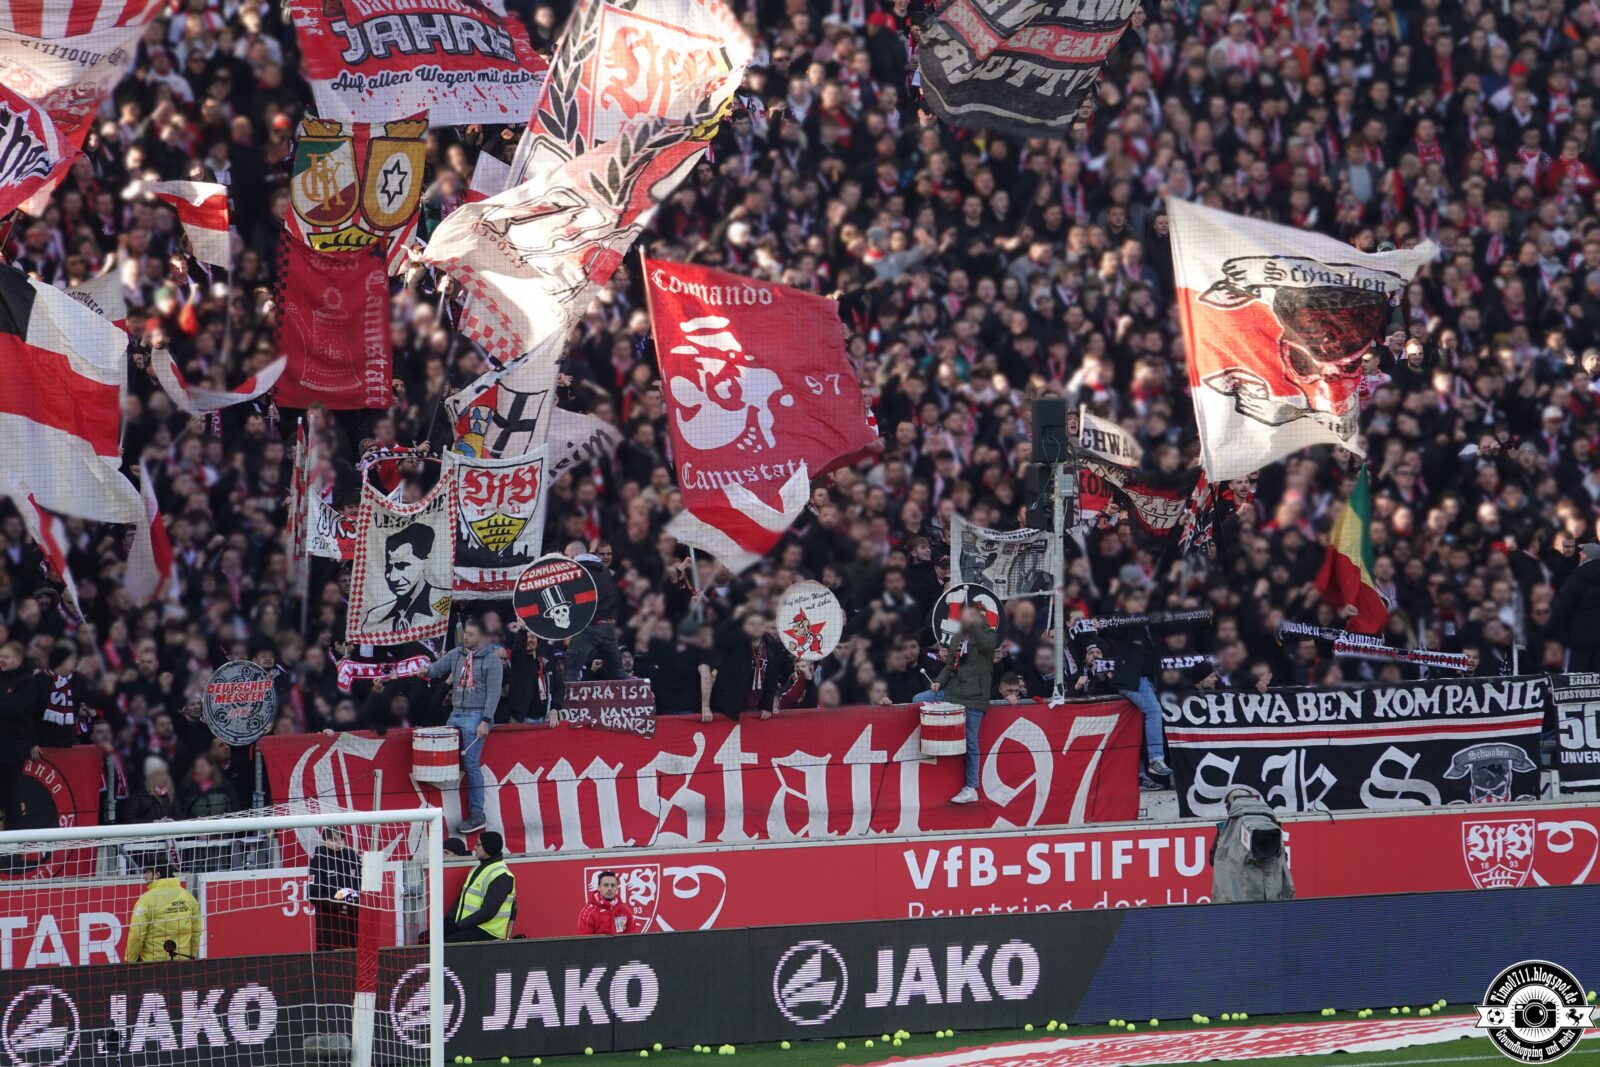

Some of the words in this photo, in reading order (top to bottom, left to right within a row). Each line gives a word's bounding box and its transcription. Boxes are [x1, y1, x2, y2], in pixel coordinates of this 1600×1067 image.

[331, 14, 518, 65] JAHRE
[331, 72, 366, 92] Auf
[367, 71, 412, 90] allen
[415, 66, 475, 89] Wegen
[477, 71, 500, 84] mit
[805, 374, 841, 396] 97
[518, 569, 582, 591] CANNSTATT
[207, 680, 272, 695] DEUTSCHER
[215, 692, 265, 704] MEISTER
[564, 685, 614, 701] LTRA
[621, 685, 651, 700] IST
[1161, 689, 1363, 725] SCHWABEN
[1373, 676, 1549, 718] KOMPANIE
[982, 713, 1120, 828] 97
[903, 834, 1291, 890] VfB-STIFTU
[482, 959, 660, 1031] JAKO
[864, 938, 1041, 1009] JAKO
[97, 982, 278, 1055] JAKO
